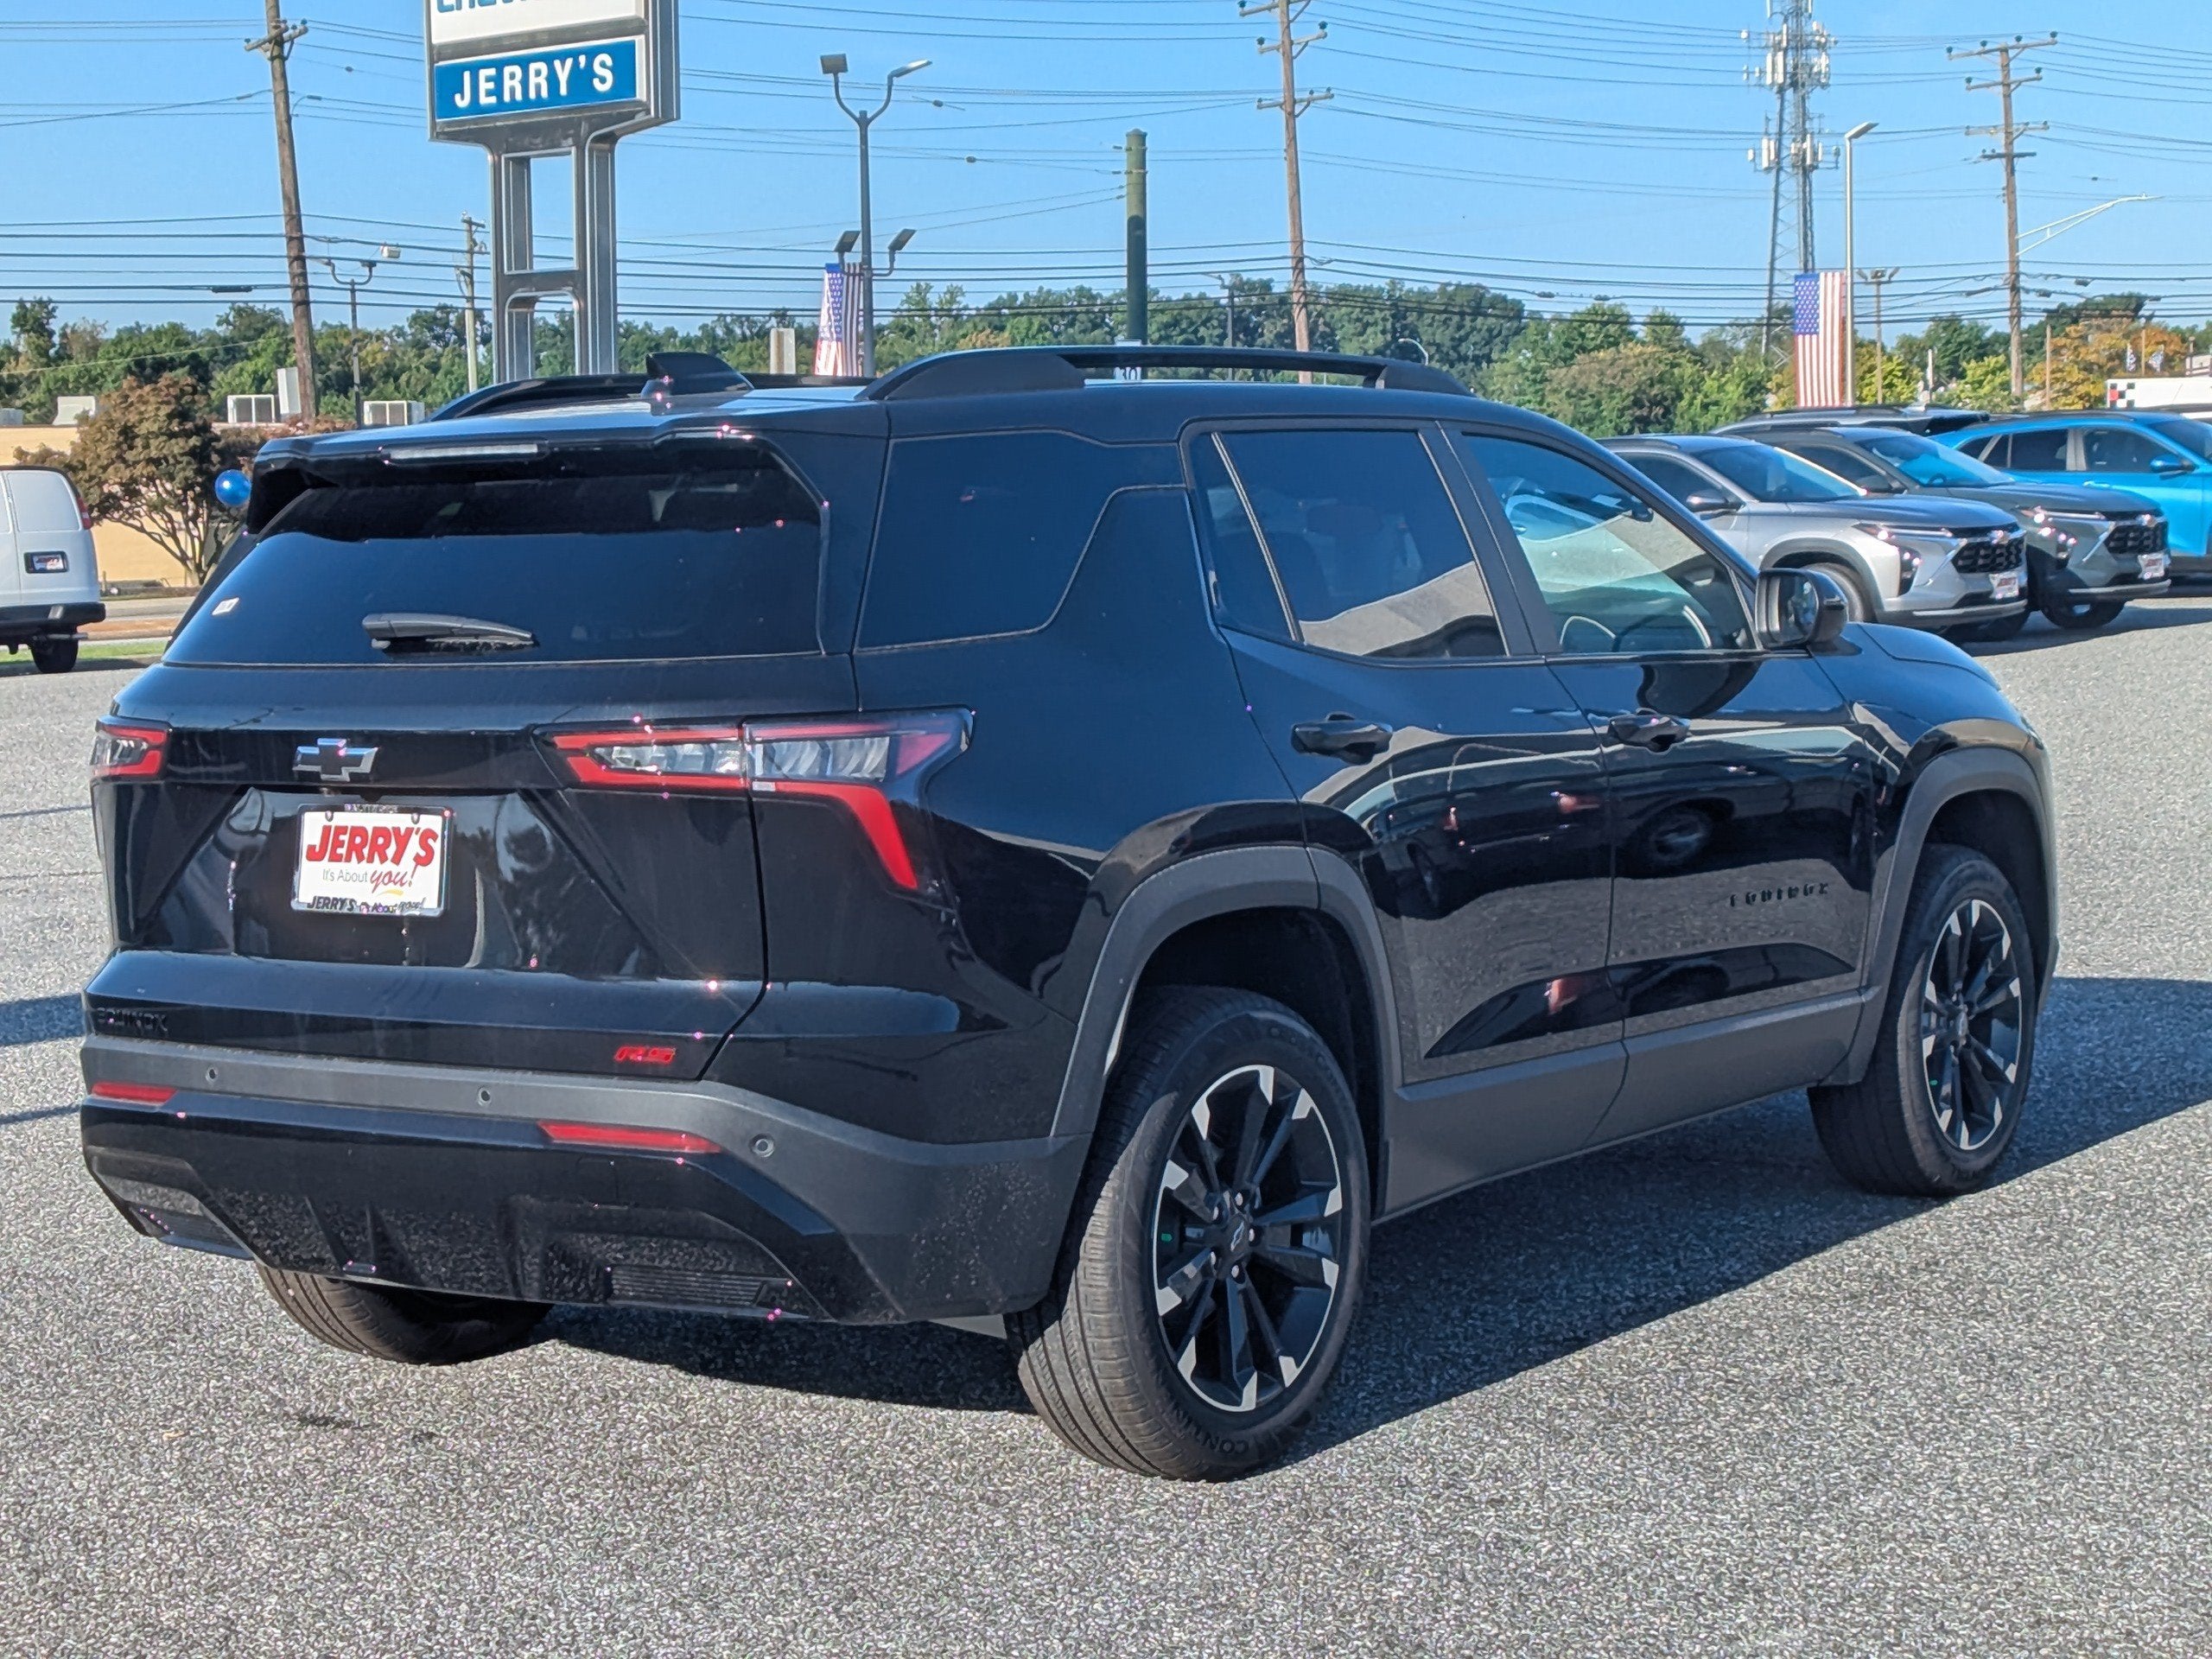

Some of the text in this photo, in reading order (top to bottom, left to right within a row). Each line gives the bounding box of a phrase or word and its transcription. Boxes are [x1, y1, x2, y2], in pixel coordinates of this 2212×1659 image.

[454, 53, 613, 108] JERRY'S
[306, 824, 439, 867] JERRY'S
[322, 865, 418, 893] It's About you!
[613, 1046, 677, 1064] RS
